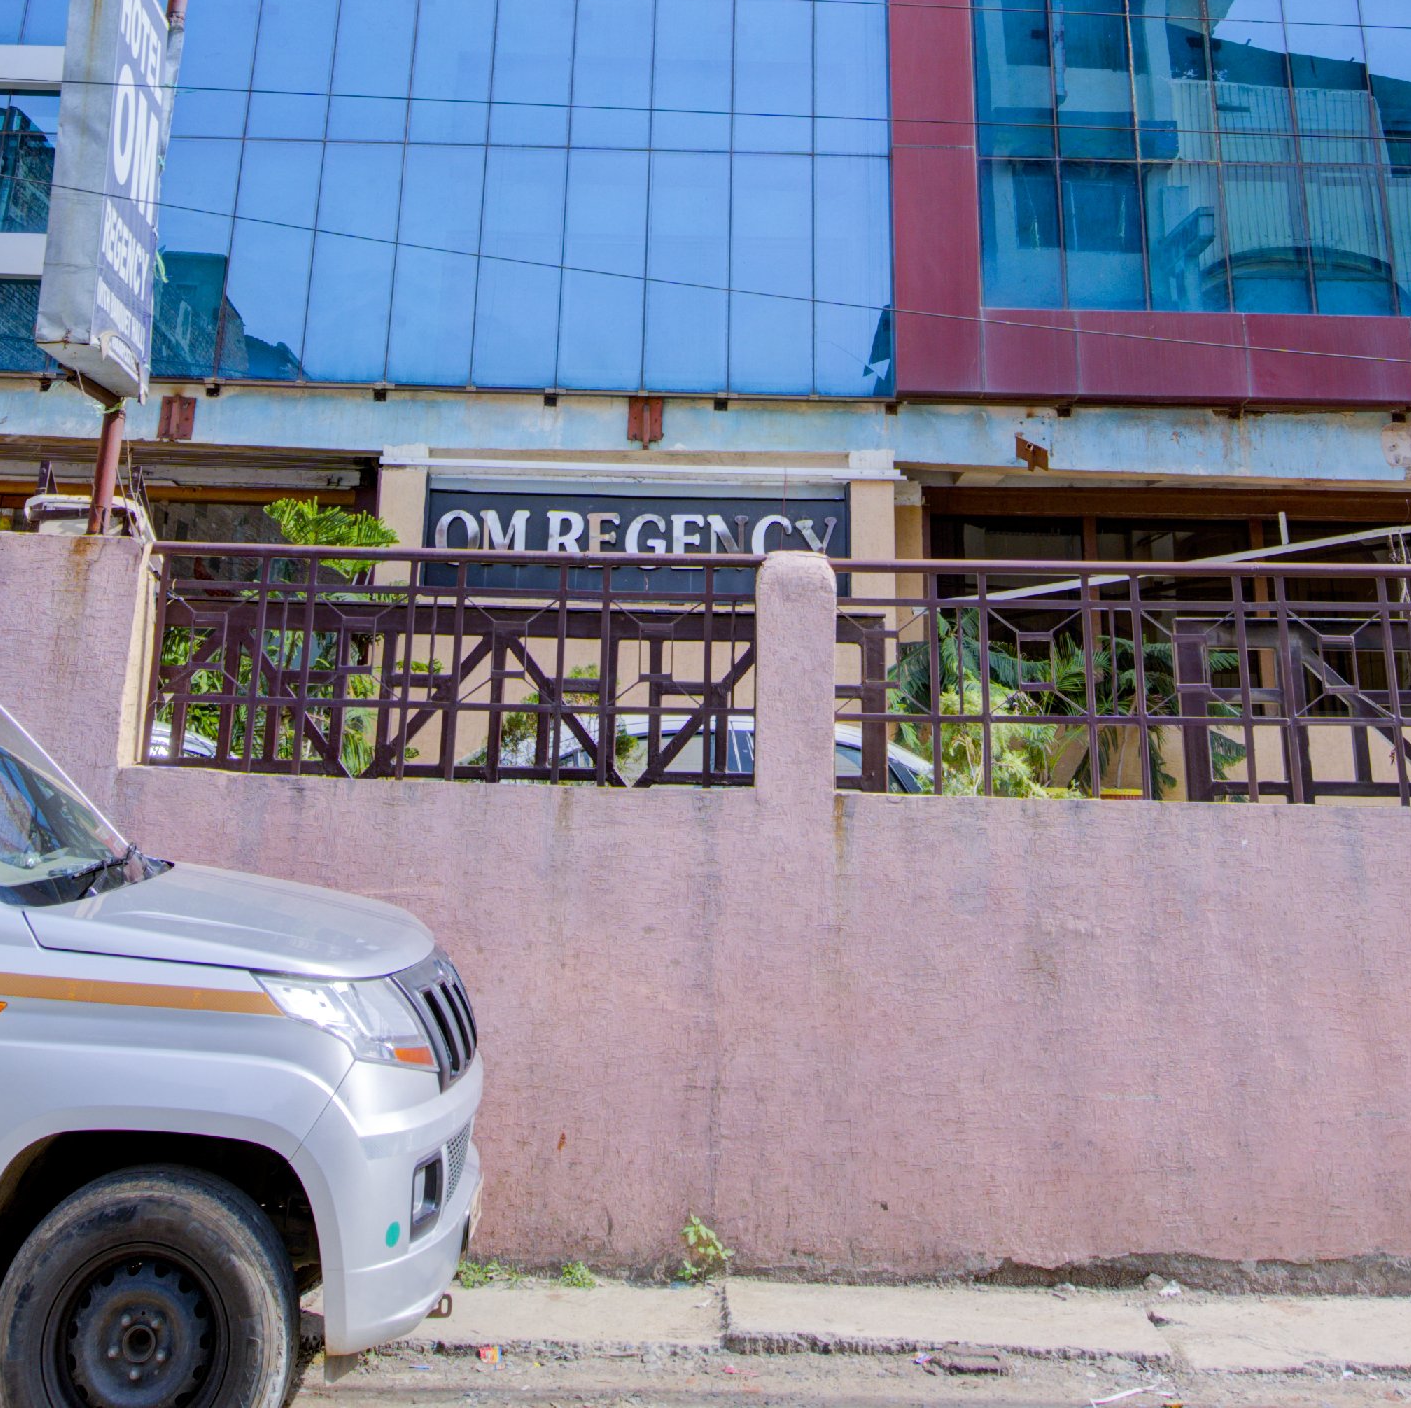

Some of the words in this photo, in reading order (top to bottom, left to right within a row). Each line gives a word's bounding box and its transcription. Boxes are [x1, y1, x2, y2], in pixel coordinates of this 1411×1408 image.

[113, 64, 159, 226] OM
[102, 198, 150, 302] REGENCY
[434, 509, 531, 568] OM
[546, 509, 838, 571] REGENCY
